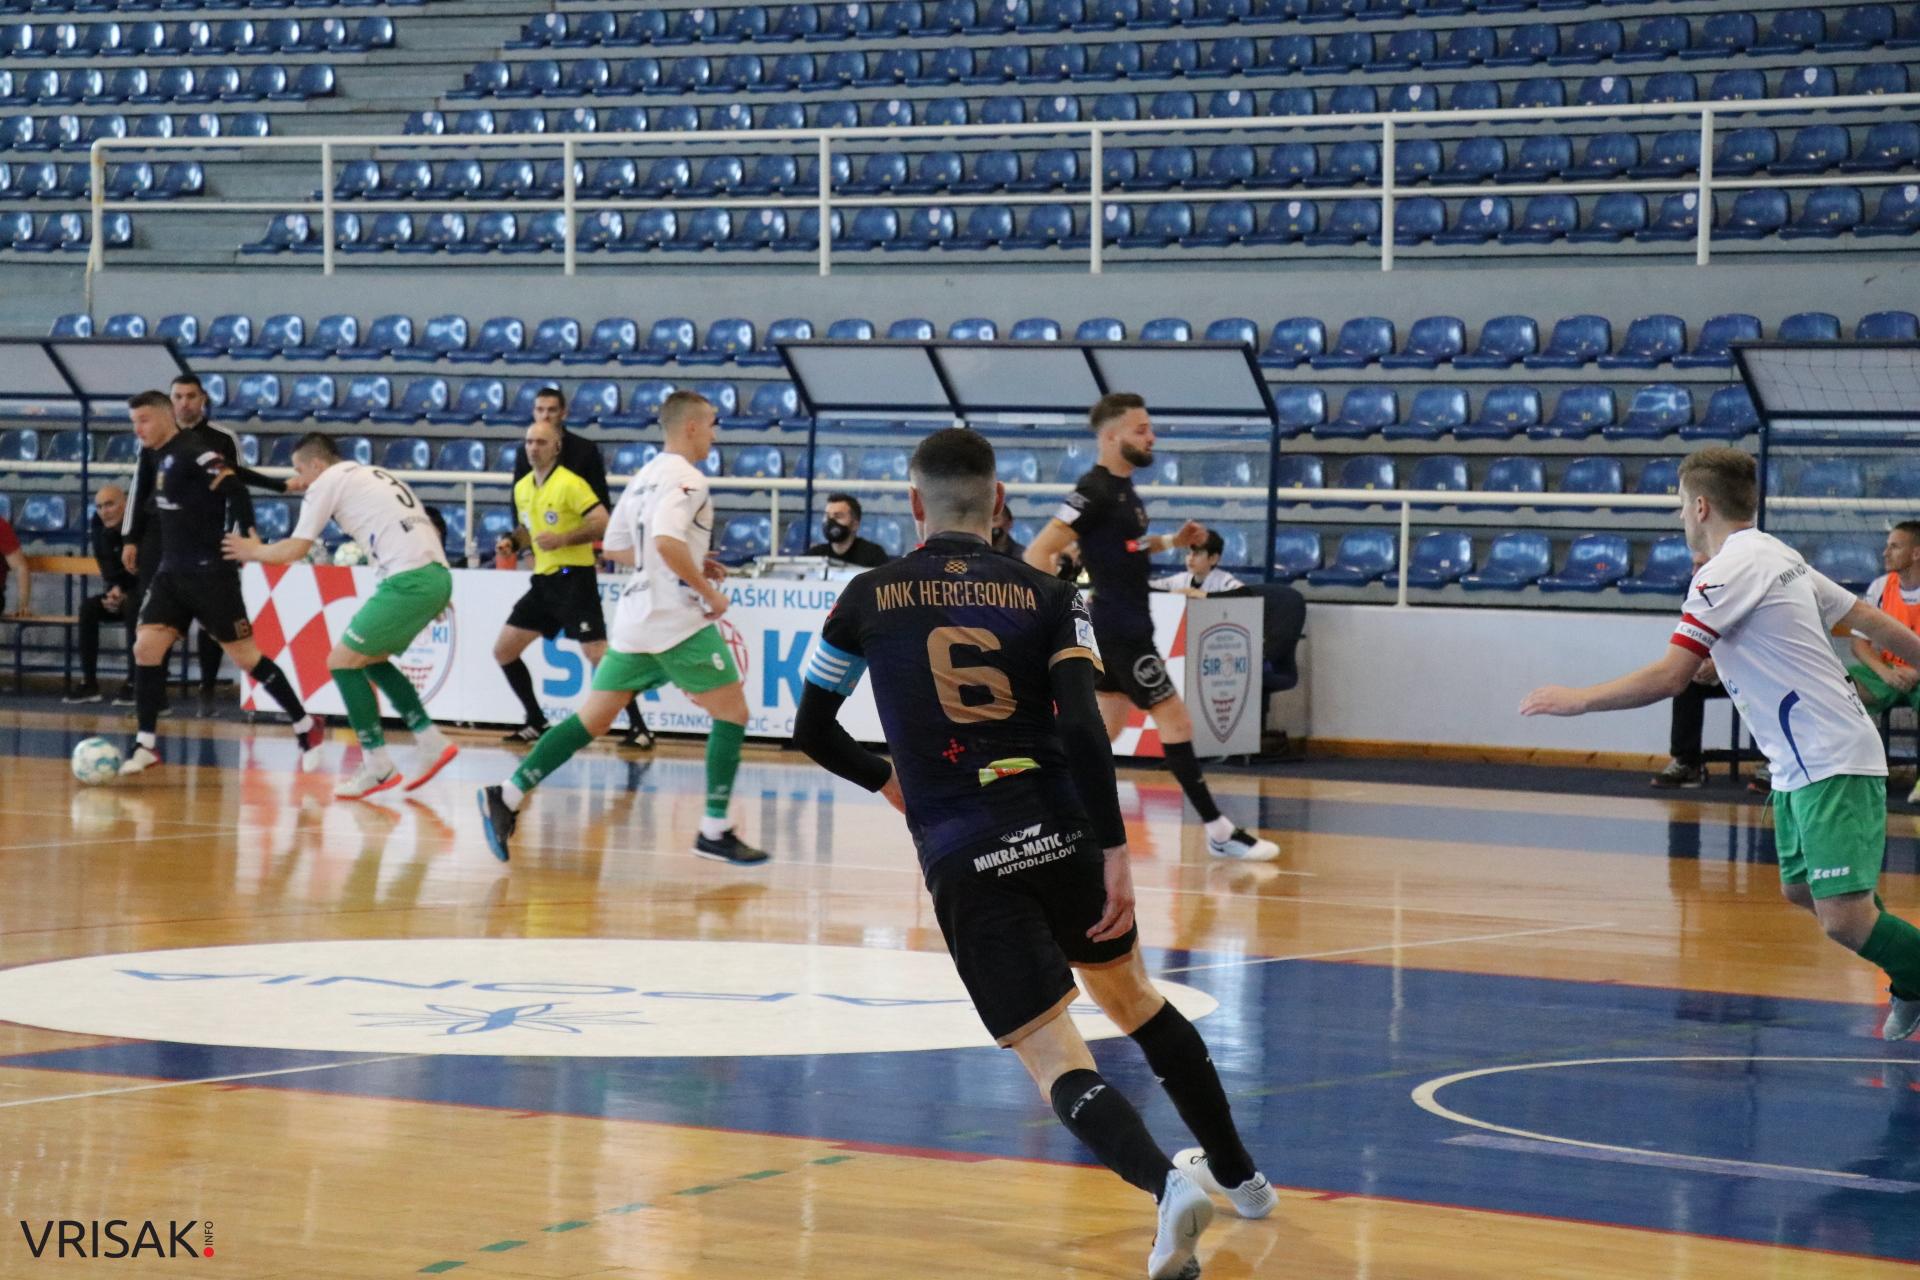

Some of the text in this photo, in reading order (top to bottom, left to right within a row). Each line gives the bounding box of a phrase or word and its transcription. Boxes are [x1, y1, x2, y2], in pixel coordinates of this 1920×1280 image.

[783, 589, 837, 610] KLUB
[875, 581, 916, 612] MNK
[920, 580, 1037, 611] HERCEGOVINA
[926, 626, 1018, 724] 6
[973, 833, 1063, 872] MIKRA-MATIC
[998, 844, 1076, 877] AUTODIJELOVI
